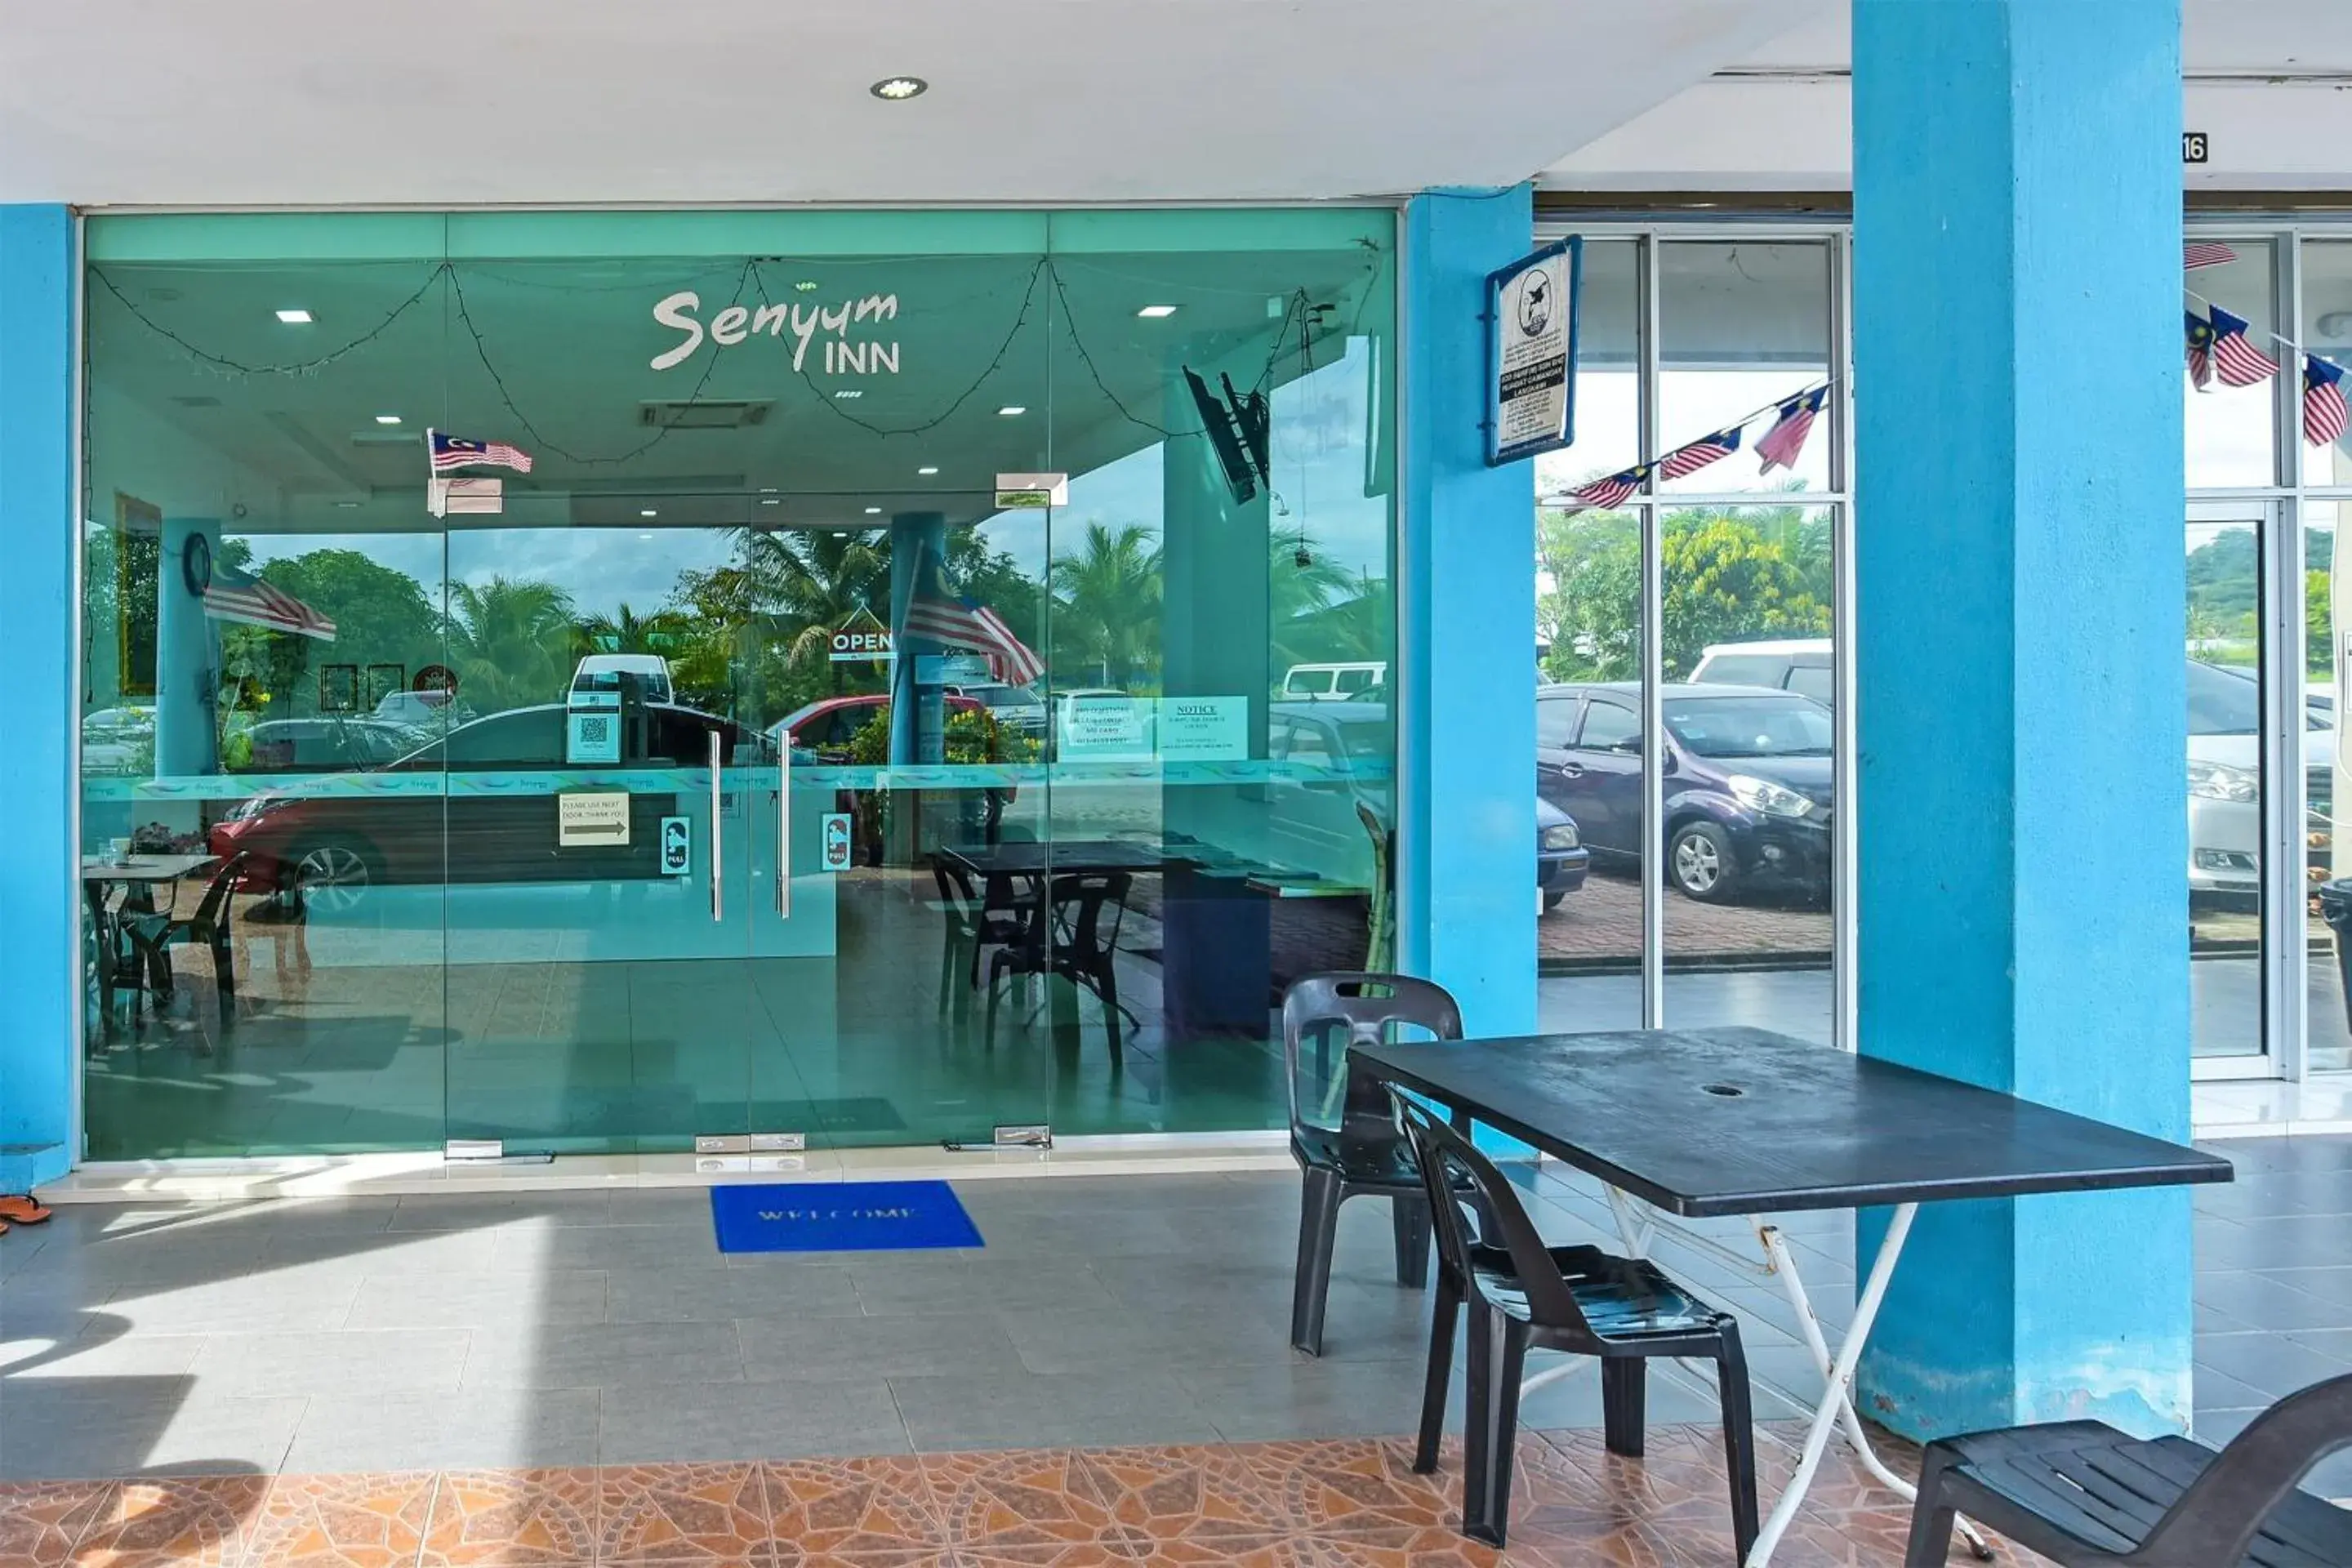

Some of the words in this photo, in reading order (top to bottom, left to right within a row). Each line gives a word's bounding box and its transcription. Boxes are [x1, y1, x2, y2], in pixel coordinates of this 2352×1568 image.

[2184, 136, 2204, 159] 16
[650, 291, 898, 372] Senyum
[826, 341, 899, 374] INN
[833, 633, 893, 650] OPEN
[1177, 706, 1217, 715] NOTICE
